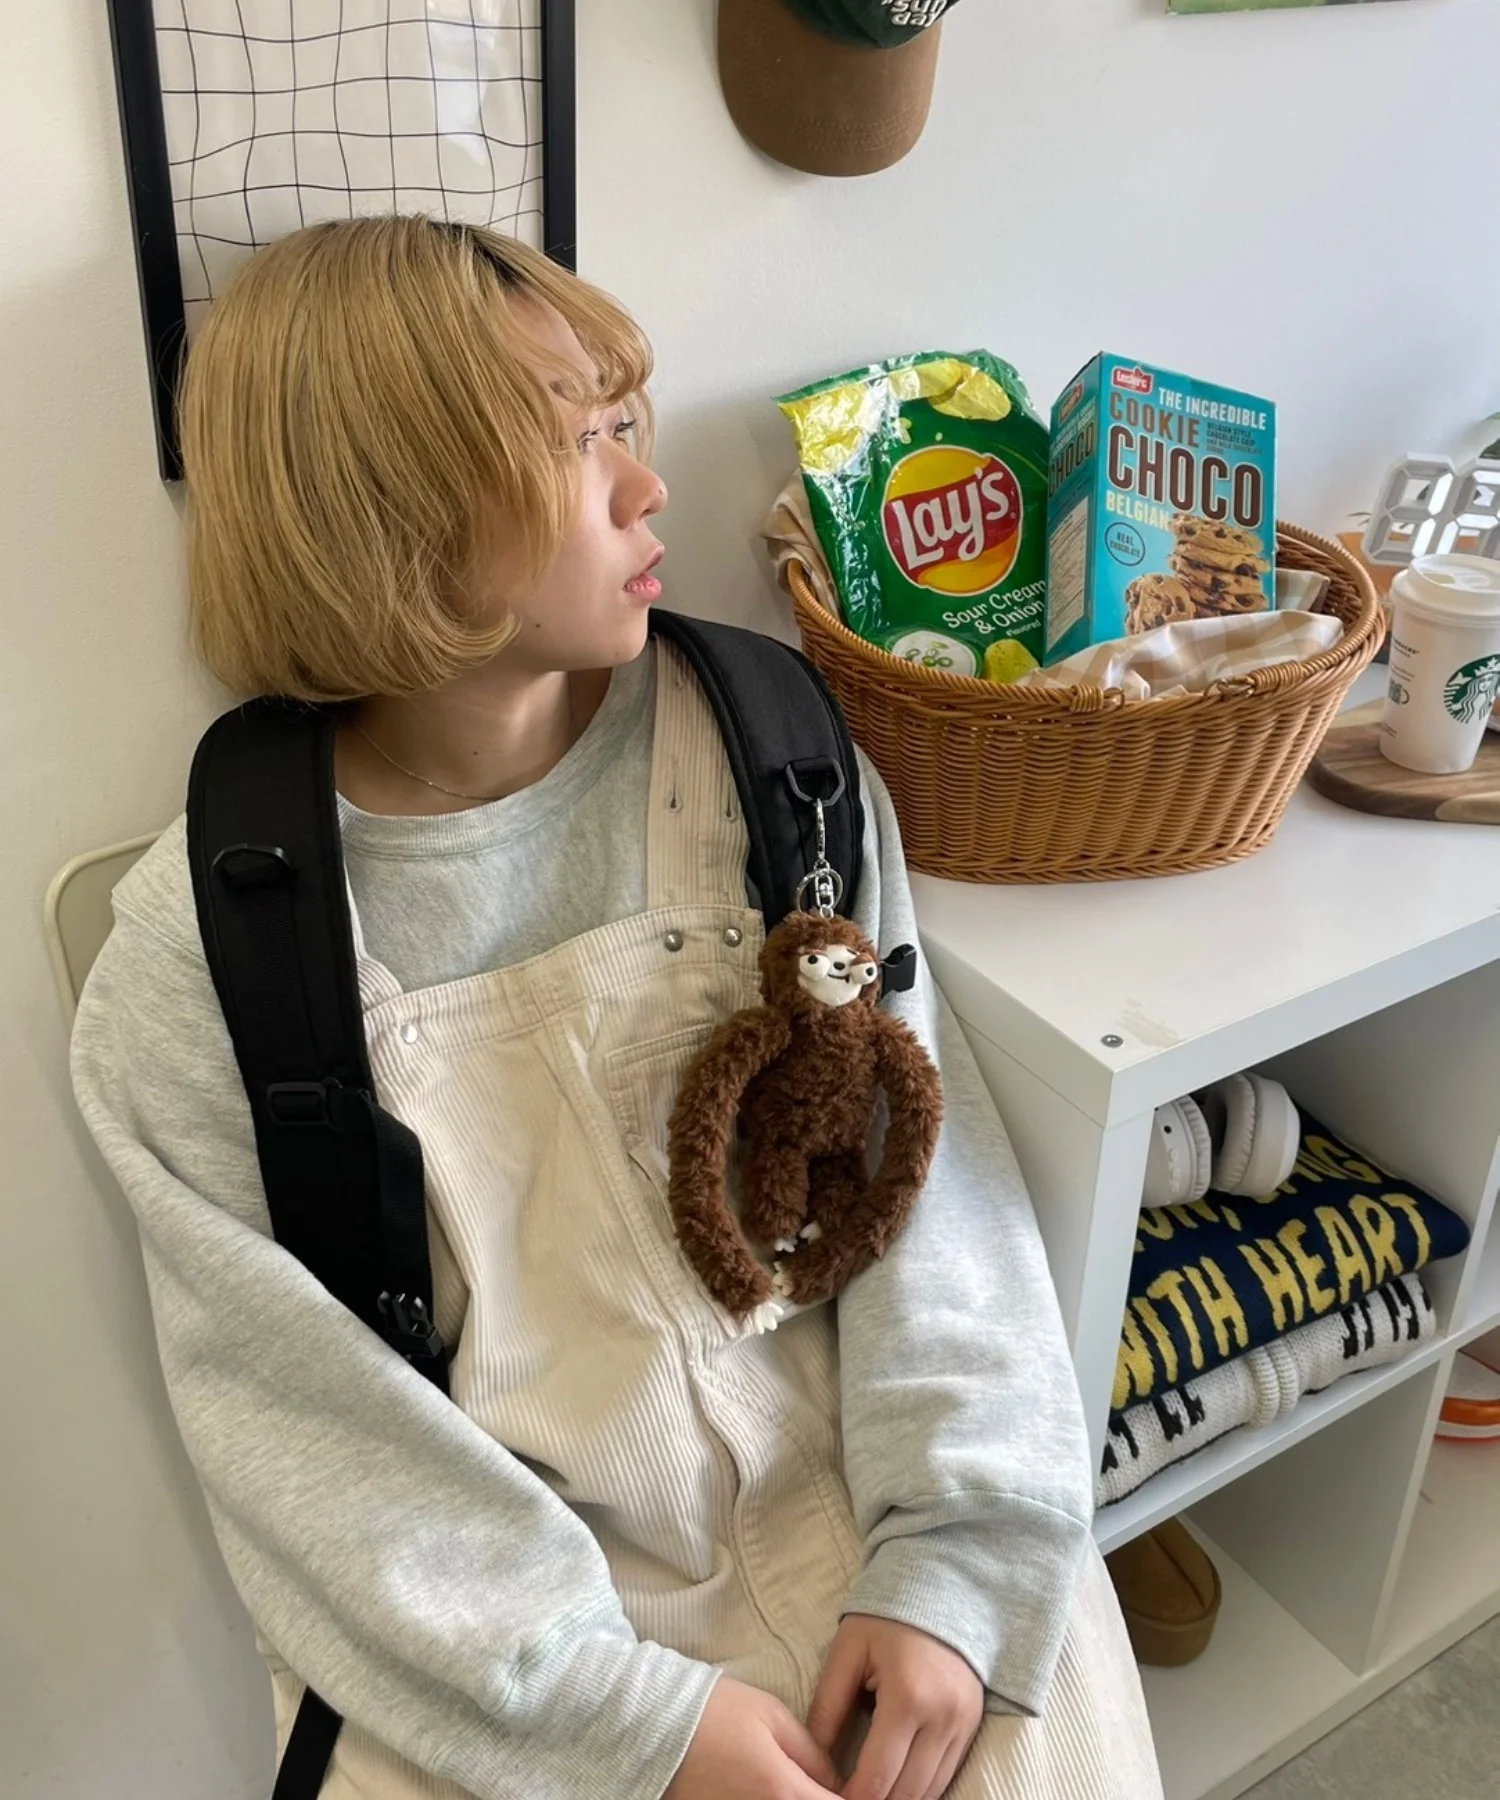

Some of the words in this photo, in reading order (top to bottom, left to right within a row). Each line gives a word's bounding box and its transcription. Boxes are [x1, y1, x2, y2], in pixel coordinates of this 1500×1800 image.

[1110, 391, 1199, 448] COOKIE
[1158, 387, 1182, 410] THE
[1186, 396, 1267, 430] INCREDIBLE
[1108, 424, 1262, 528] CHOCO
[892, 466, 1010, 570] Lay's
[1106, 490, 1169, 531] BELGIAN
[942, 603, 988, 628] Sour
[989, 580, 1046, 609] Cream
[974, 620, 996, 634] &
[992, 600, 1044, 627] Onion
[1237, 1193, 1431, 1331] HEART
